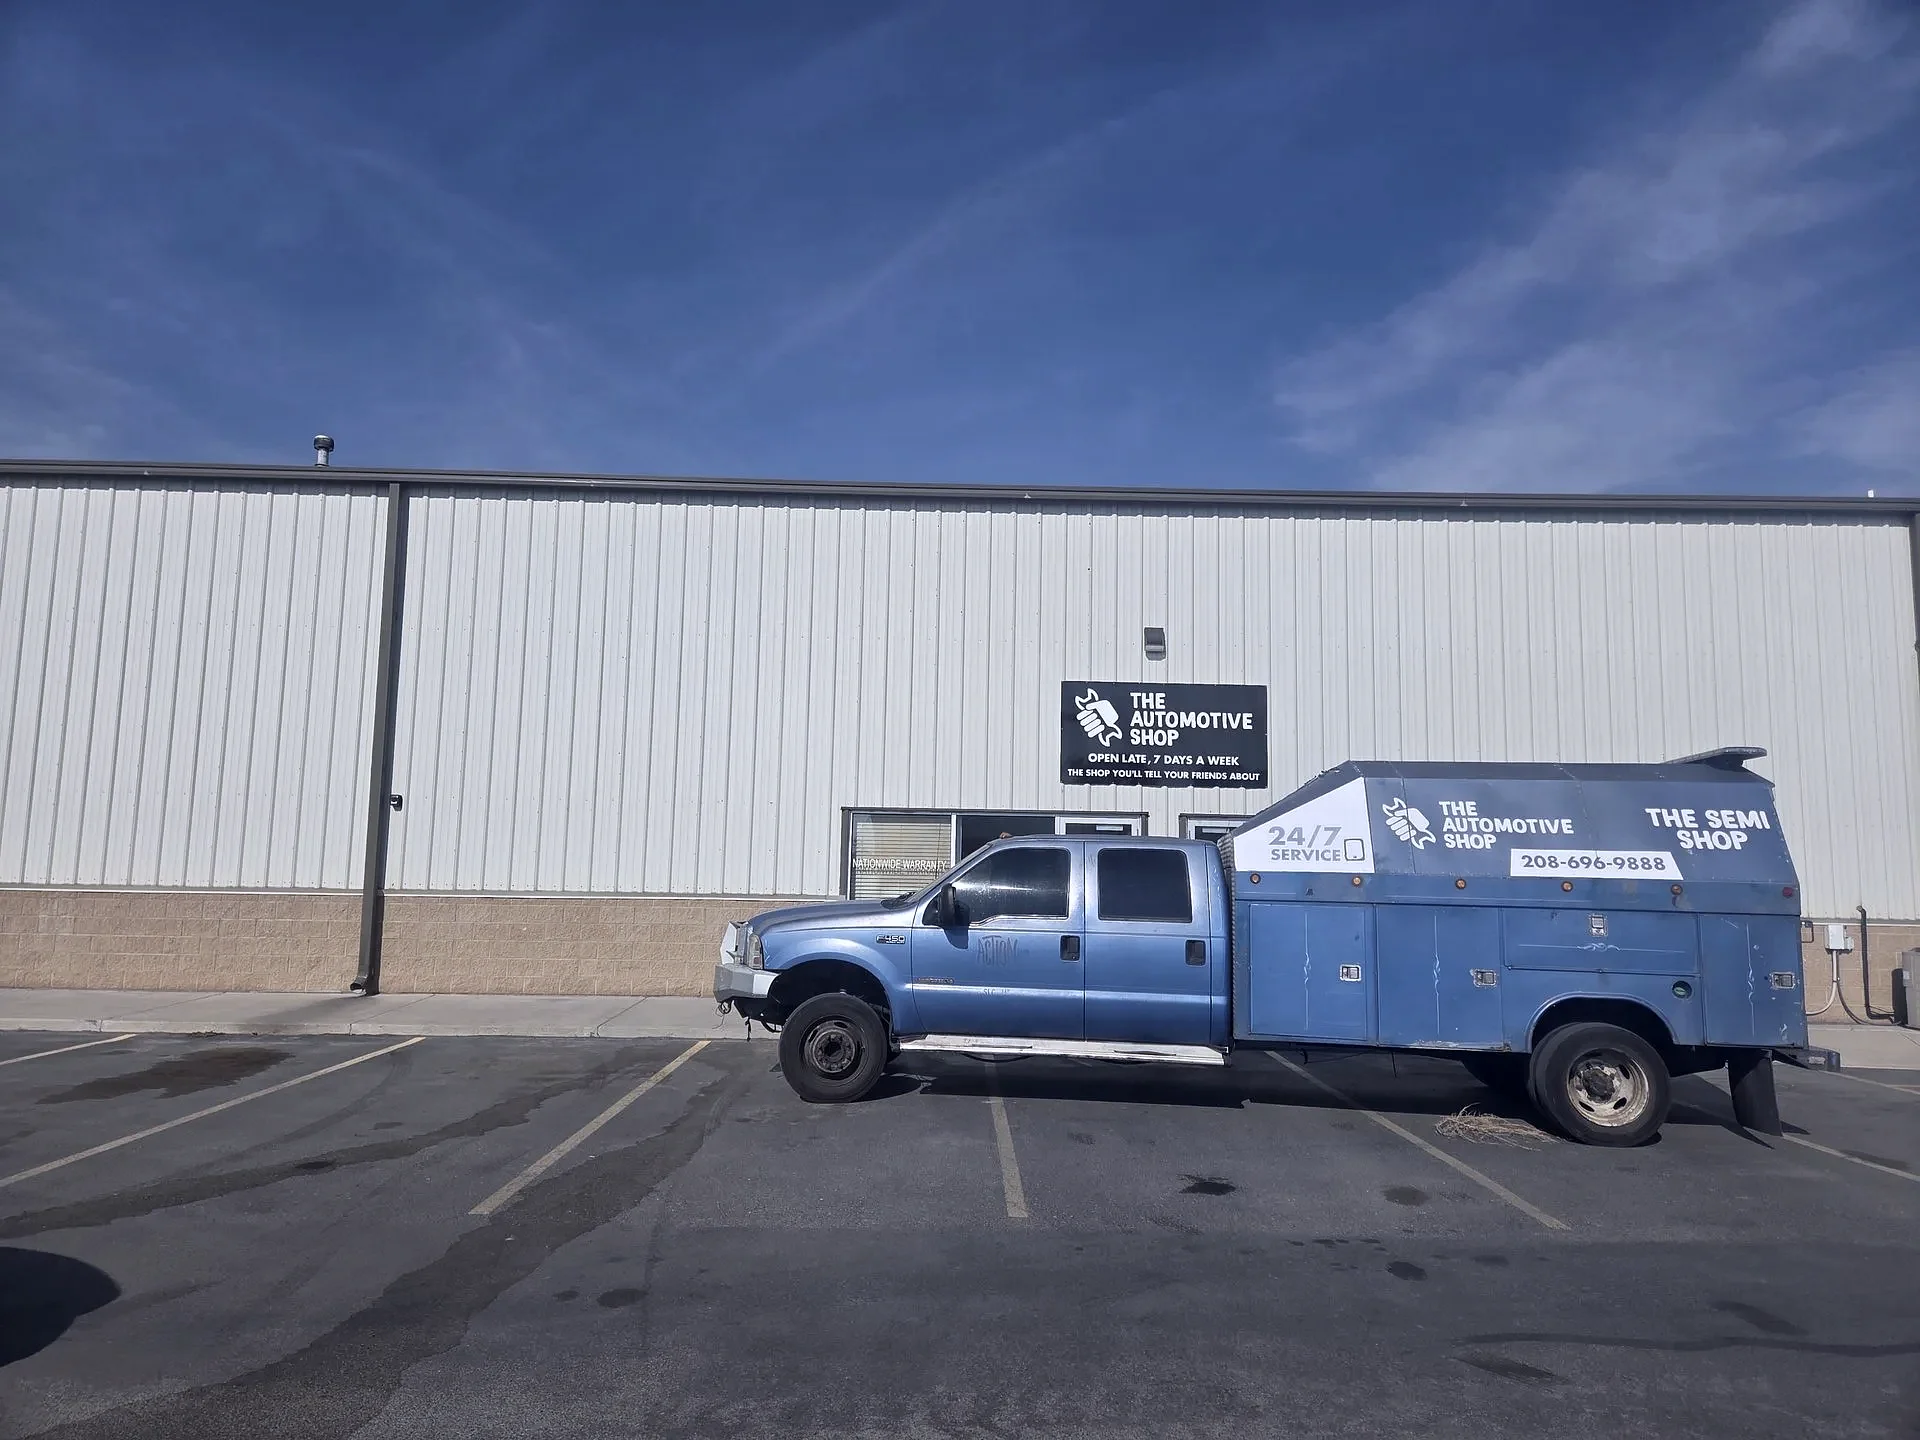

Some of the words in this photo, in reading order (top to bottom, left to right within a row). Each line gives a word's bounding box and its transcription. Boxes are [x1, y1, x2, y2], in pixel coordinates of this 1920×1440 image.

[1130, 692, 1166, 709] THE
[1130, 711, 1253, 730] AUTOMOTIVE
[1130, 729, 1179, 746] SHOP
[1088, 753, 1119, 763] OPEN
[1122, 754, 1151, 765] LATE,
[1153, 755, 1160, 764] 7
[1164, 755, 1193, 765] DAYS
[1196, 756, 1205, 765] A
[1208, 756, 1239, 766] WEEK
[1067, 769, 1084, 777] THE
[1085, 769, 1110, 778] SHOP
[1112, 769, 1142, 778] YOU'LL
[1144, 770, 1162, 779] TELL
[1164, 770, 1189, 779] YOUR
[1191, 771, 1227, 780] FRIENDS
[1229, 772, 1260, 781] ABOUT
[1439, 800, 1478, 817] THE
[1442, 817, 1574, 835] AUTOMOTIVE
[1645, 808, 1699, 829] THE
[1705, 809, 1771, 830] SEMI
[1268, 825, 1342, 848] 24/7
[1444, 833, 1497, 850] SHOP
[1676, 829, 1748, 851] SHOP
[1271, 849, 1342, 862] SERVICE
[1521, 855, 1666, 871] 208-696-9888
[852, 858, 901, 869] NATIONWIDE
[902, 859, 947, 871] WARRANTY
